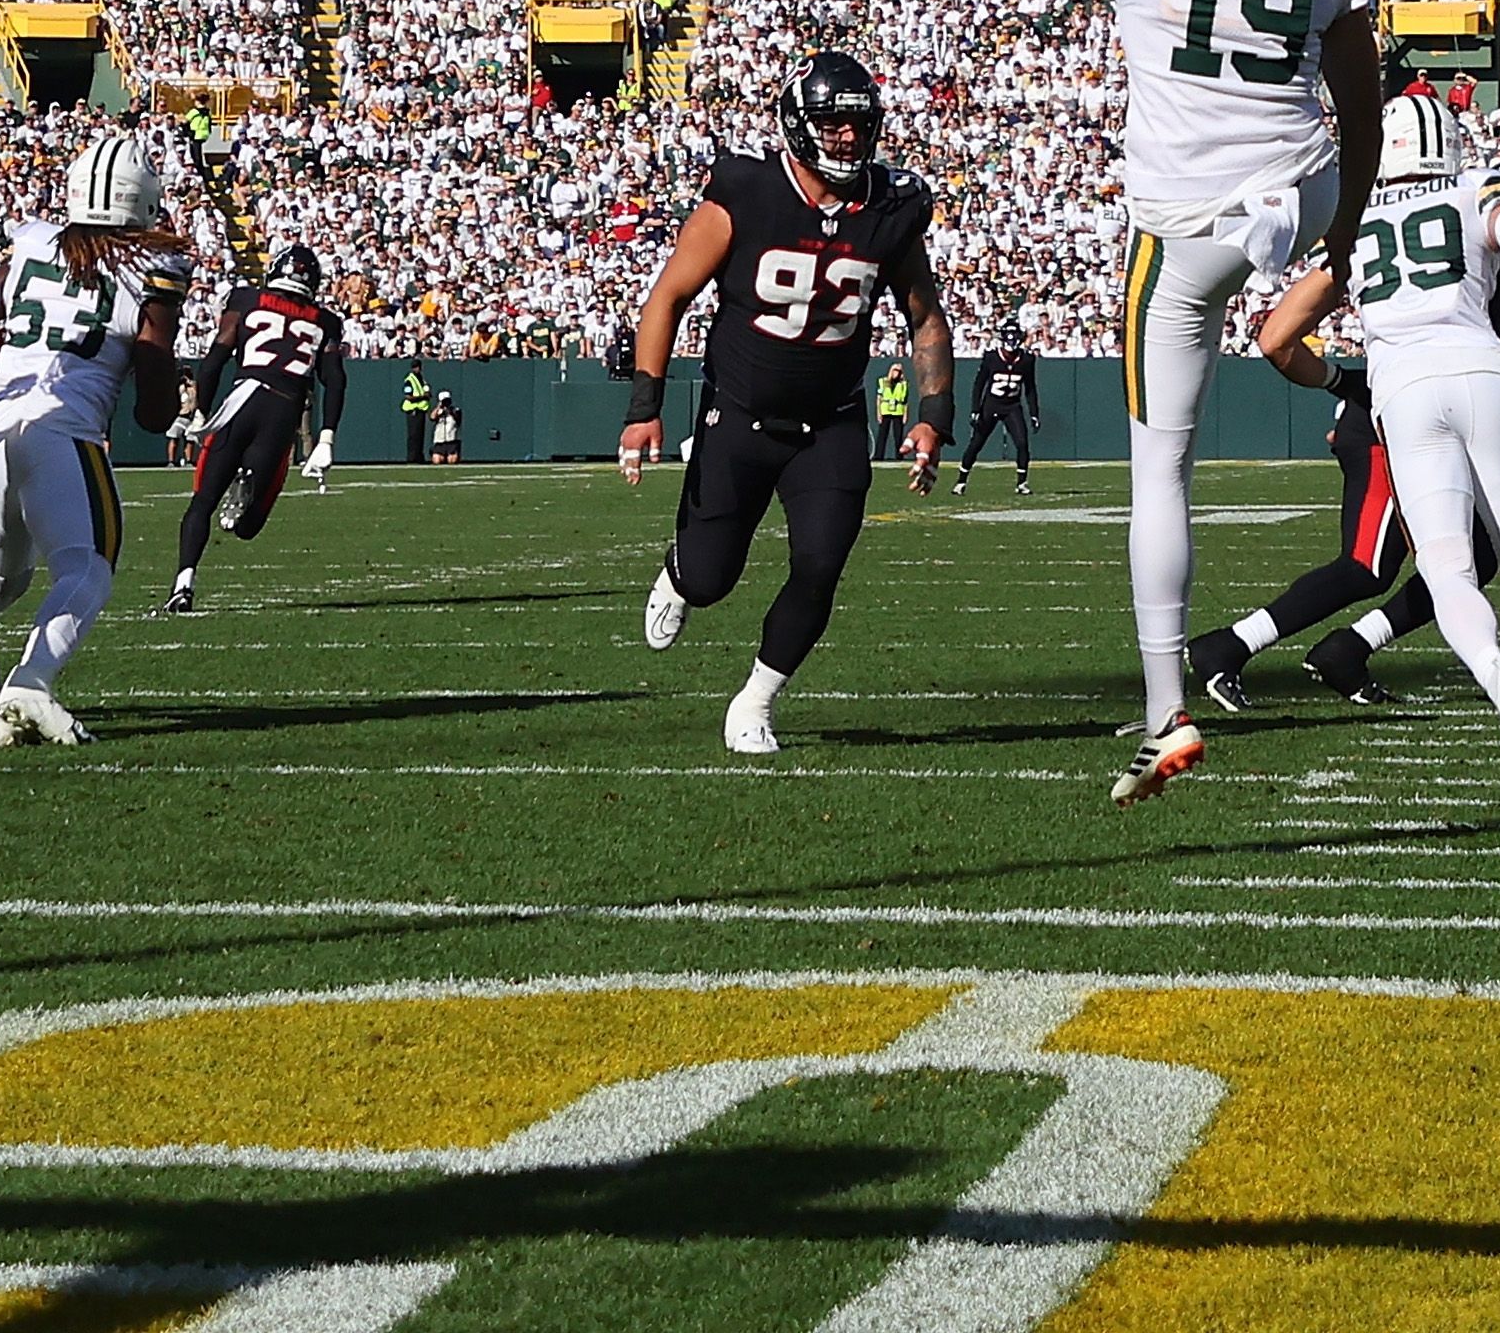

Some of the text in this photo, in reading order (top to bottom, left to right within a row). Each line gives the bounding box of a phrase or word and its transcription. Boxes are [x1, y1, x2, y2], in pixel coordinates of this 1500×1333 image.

[1365, 176, 1459, 209] DERSON
[753, 247, 880, 344] 93
[1358, 202, 1468, 307] 39
[8, 257, 118, 361] 53
[242, 309, 325, 376] 23
[990, 372, 1023, 398] 25
